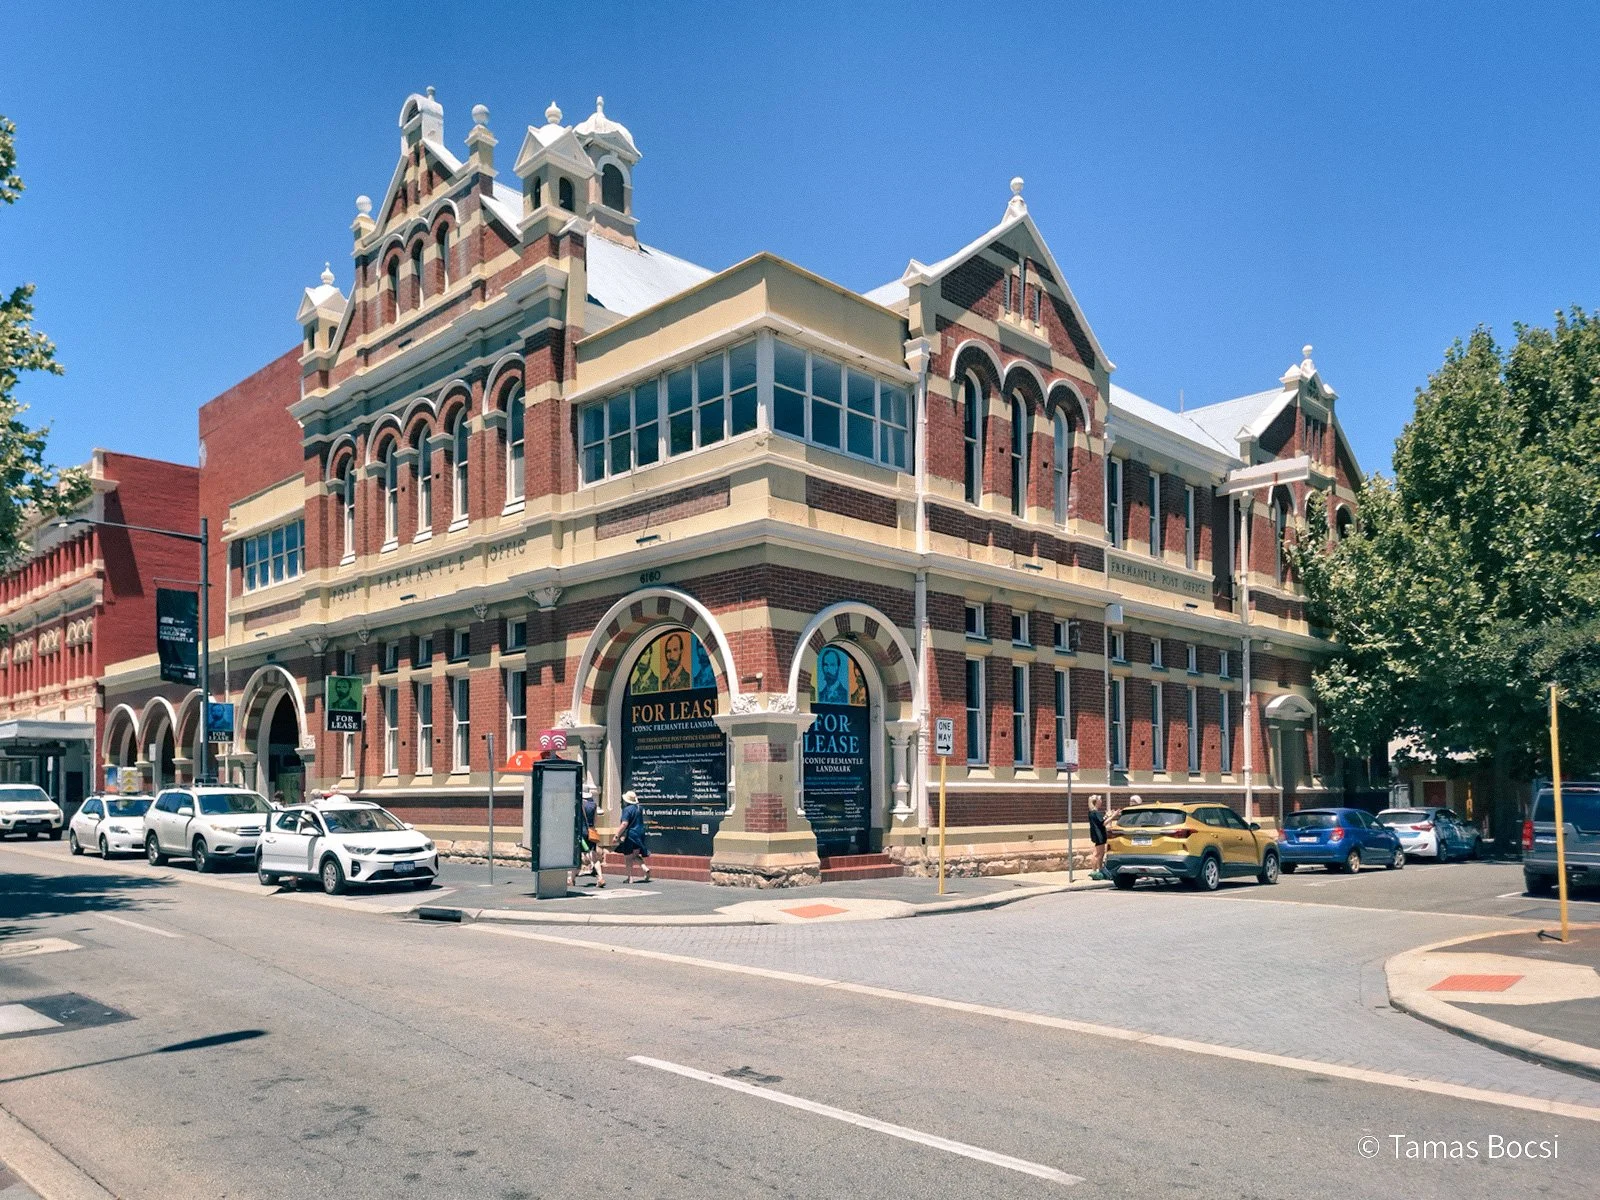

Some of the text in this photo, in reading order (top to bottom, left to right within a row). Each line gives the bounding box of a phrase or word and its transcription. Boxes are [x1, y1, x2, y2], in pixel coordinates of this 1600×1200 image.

[332, 584, 358, 603] POST
[378, 555, 466, 591] FREMANTLE
[640, 570, 661, 584] 6160
[1111, 562, 1206, 594] FREMANTLE POST OFFICE
[631, 703, 665, 723] FOR
[331, 721, 358, 729] LEASE
[653, 722, 689, 731] FREMANTLE
[814, 713, 850, 732] FOR
[939, 721, 951, 730] ONE
[938, 733, 952, 741] WAY
[804, 734, 860, 753] LEASE
[804, 757, 864, 765] CONIC FREMANTLE
[815, 765, 851, 773] LANDMARK
[653, 809, 672, 817] potential
